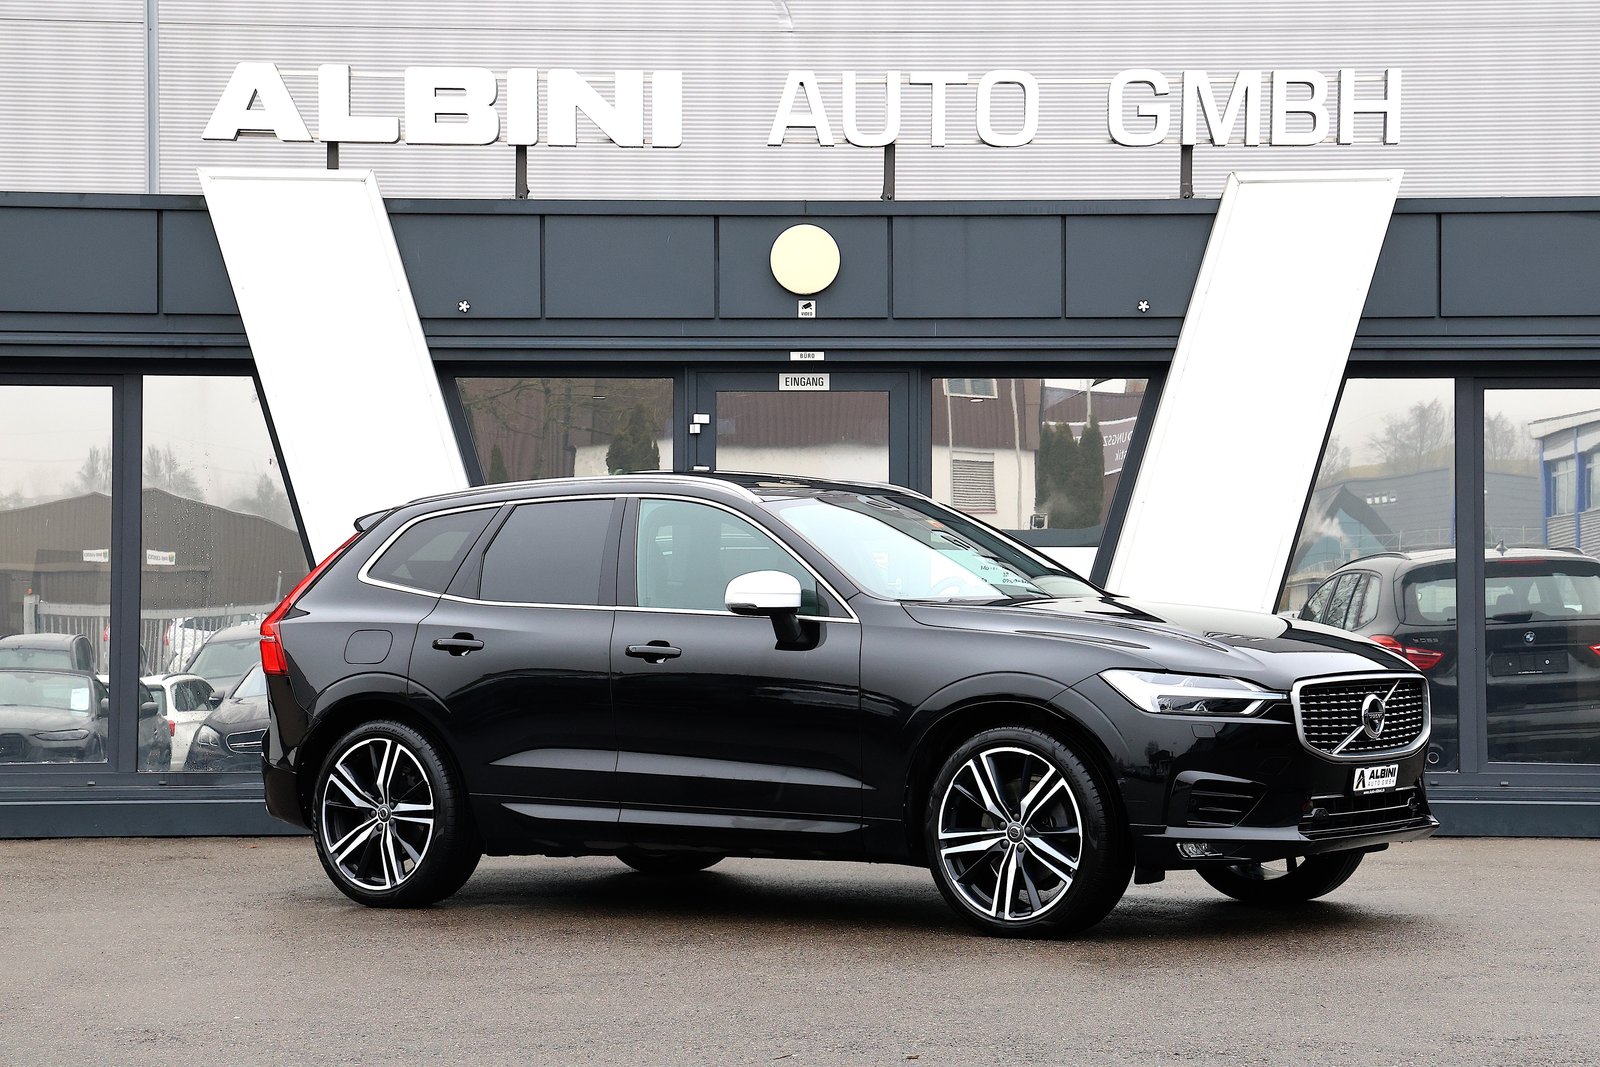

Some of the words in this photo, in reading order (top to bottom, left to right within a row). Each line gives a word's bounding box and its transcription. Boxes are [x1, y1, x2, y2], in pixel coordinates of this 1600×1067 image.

[202, 61, 683, 148] ALBINI
[767, 69, 1040, 148] AUTO
[1107, 68, 1402, 147] GMBH
[785, 377, 824, 387] EINGANG
[1369, 767, 1396, 780] ALBINI
